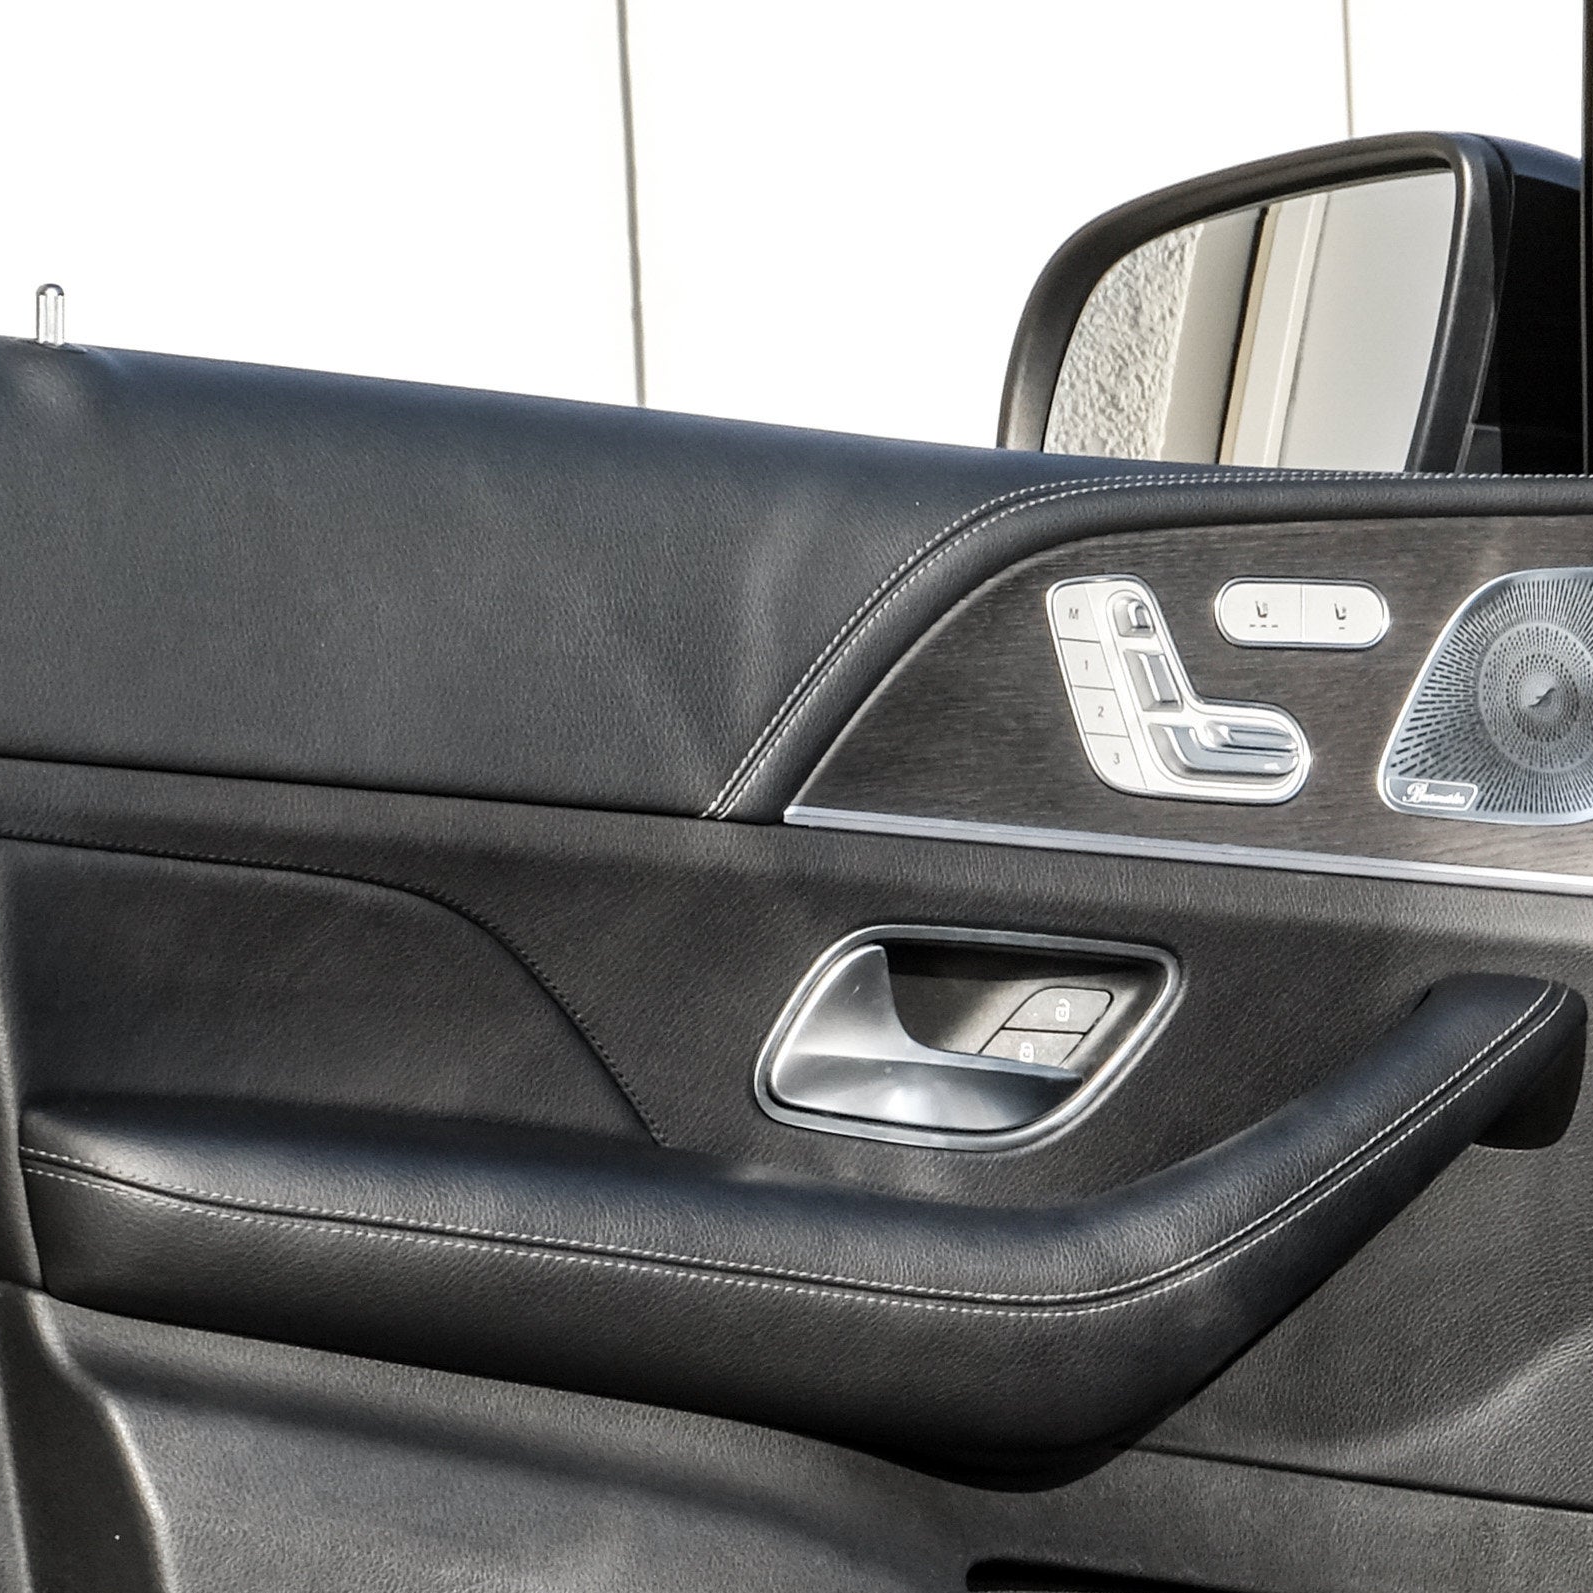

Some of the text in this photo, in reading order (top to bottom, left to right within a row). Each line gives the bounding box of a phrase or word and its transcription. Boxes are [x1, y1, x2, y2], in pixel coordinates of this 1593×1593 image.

[1068, 607, 1080, 620] M
[1097, 705, 1105, 718] 2
[1113, 752, 1121, 765] 3
